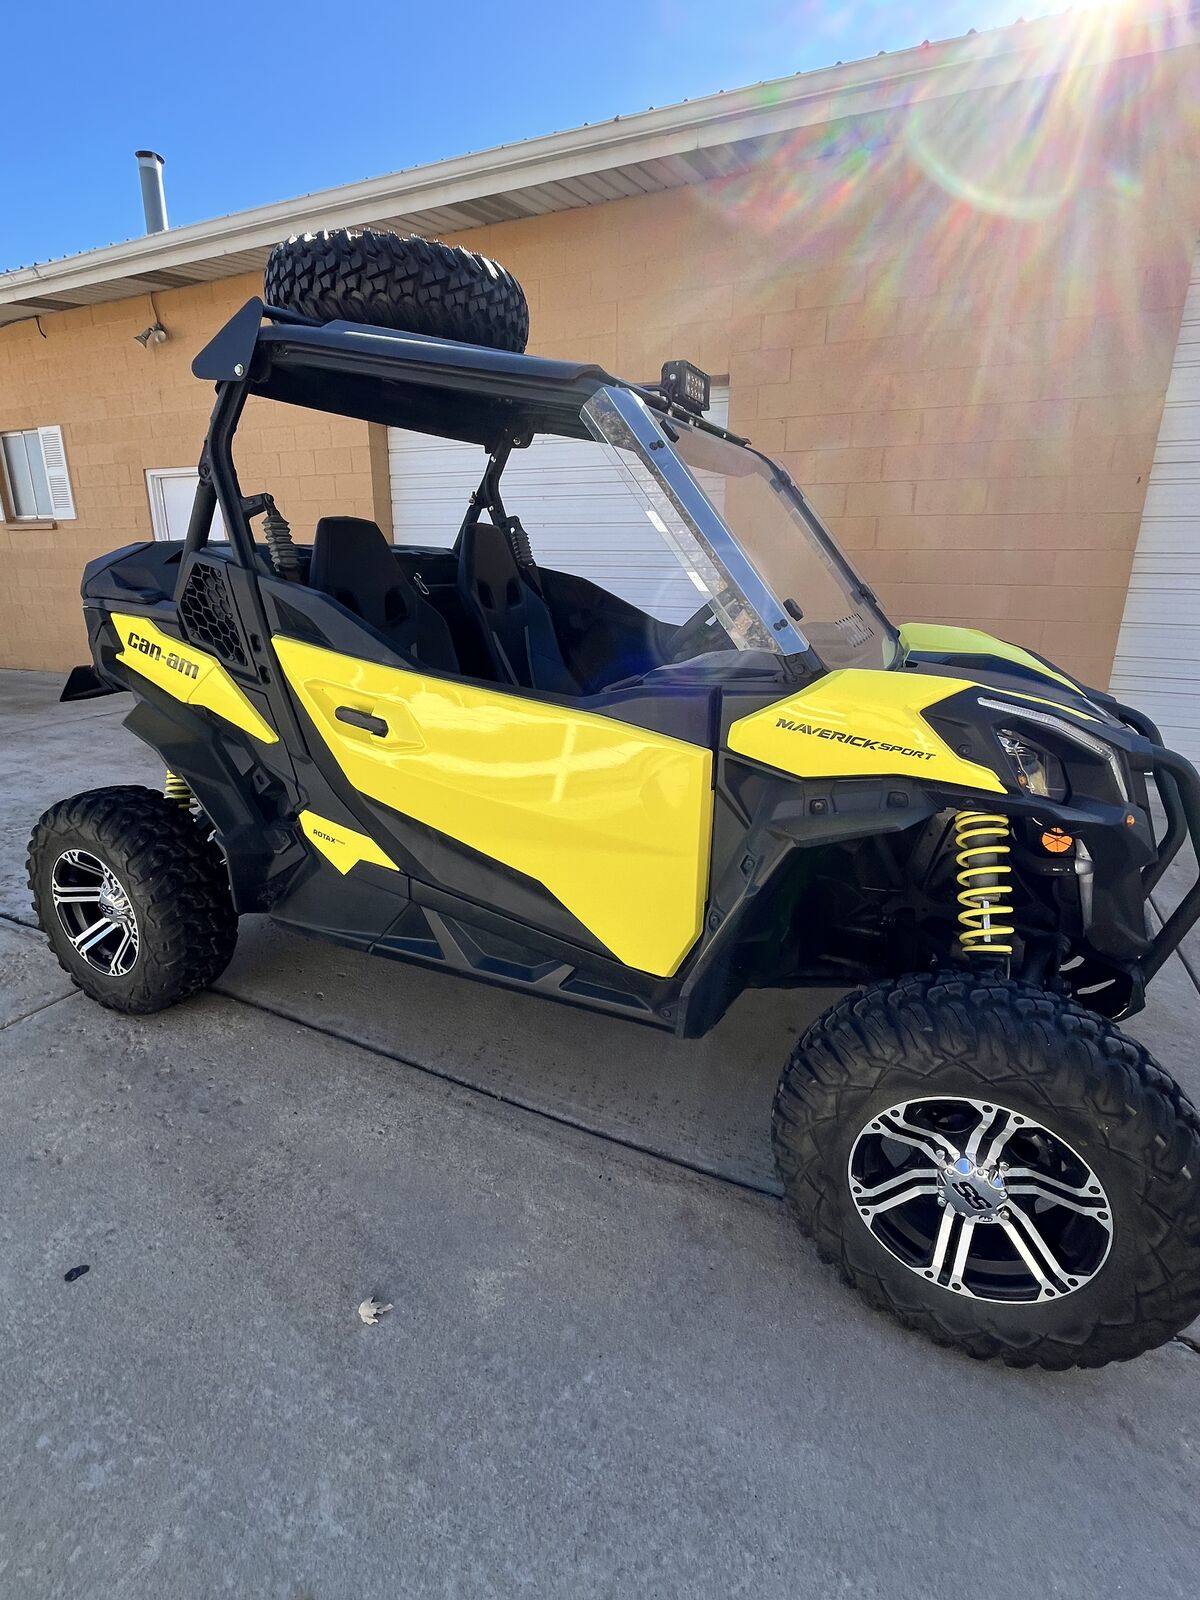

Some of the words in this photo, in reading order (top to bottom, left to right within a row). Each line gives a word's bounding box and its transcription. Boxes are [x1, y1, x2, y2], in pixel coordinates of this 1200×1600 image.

[127, 632, 200, 680] can-am
[775, 718, 881, 751] MAVERICK
[878, 742, 937, 761] SPORT
[312, 828, 336, 844] ROTAX
